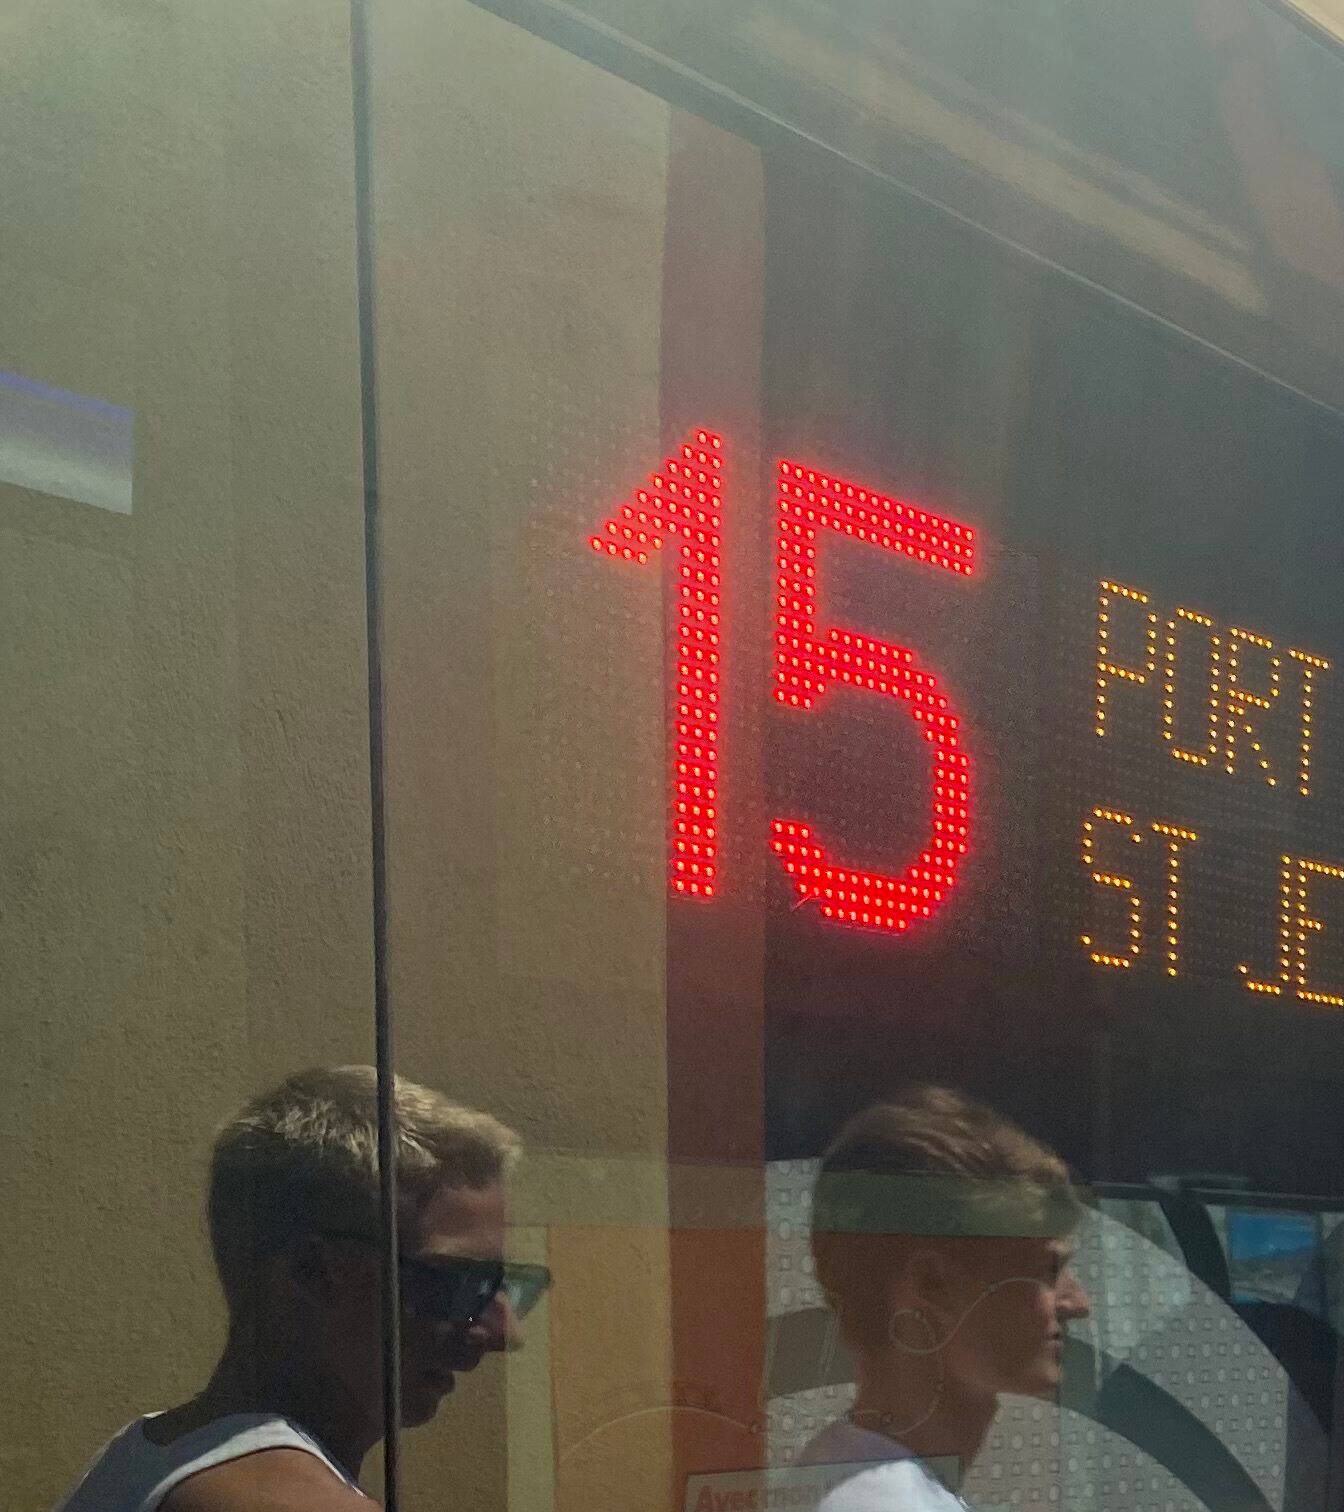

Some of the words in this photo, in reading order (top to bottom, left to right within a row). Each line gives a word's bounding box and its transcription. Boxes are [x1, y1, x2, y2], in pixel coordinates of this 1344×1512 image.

[588, 428, 979, 932] 15
[1096, 578, 1331, 798] PORT
[1080, 807, 1197, 978] ST
